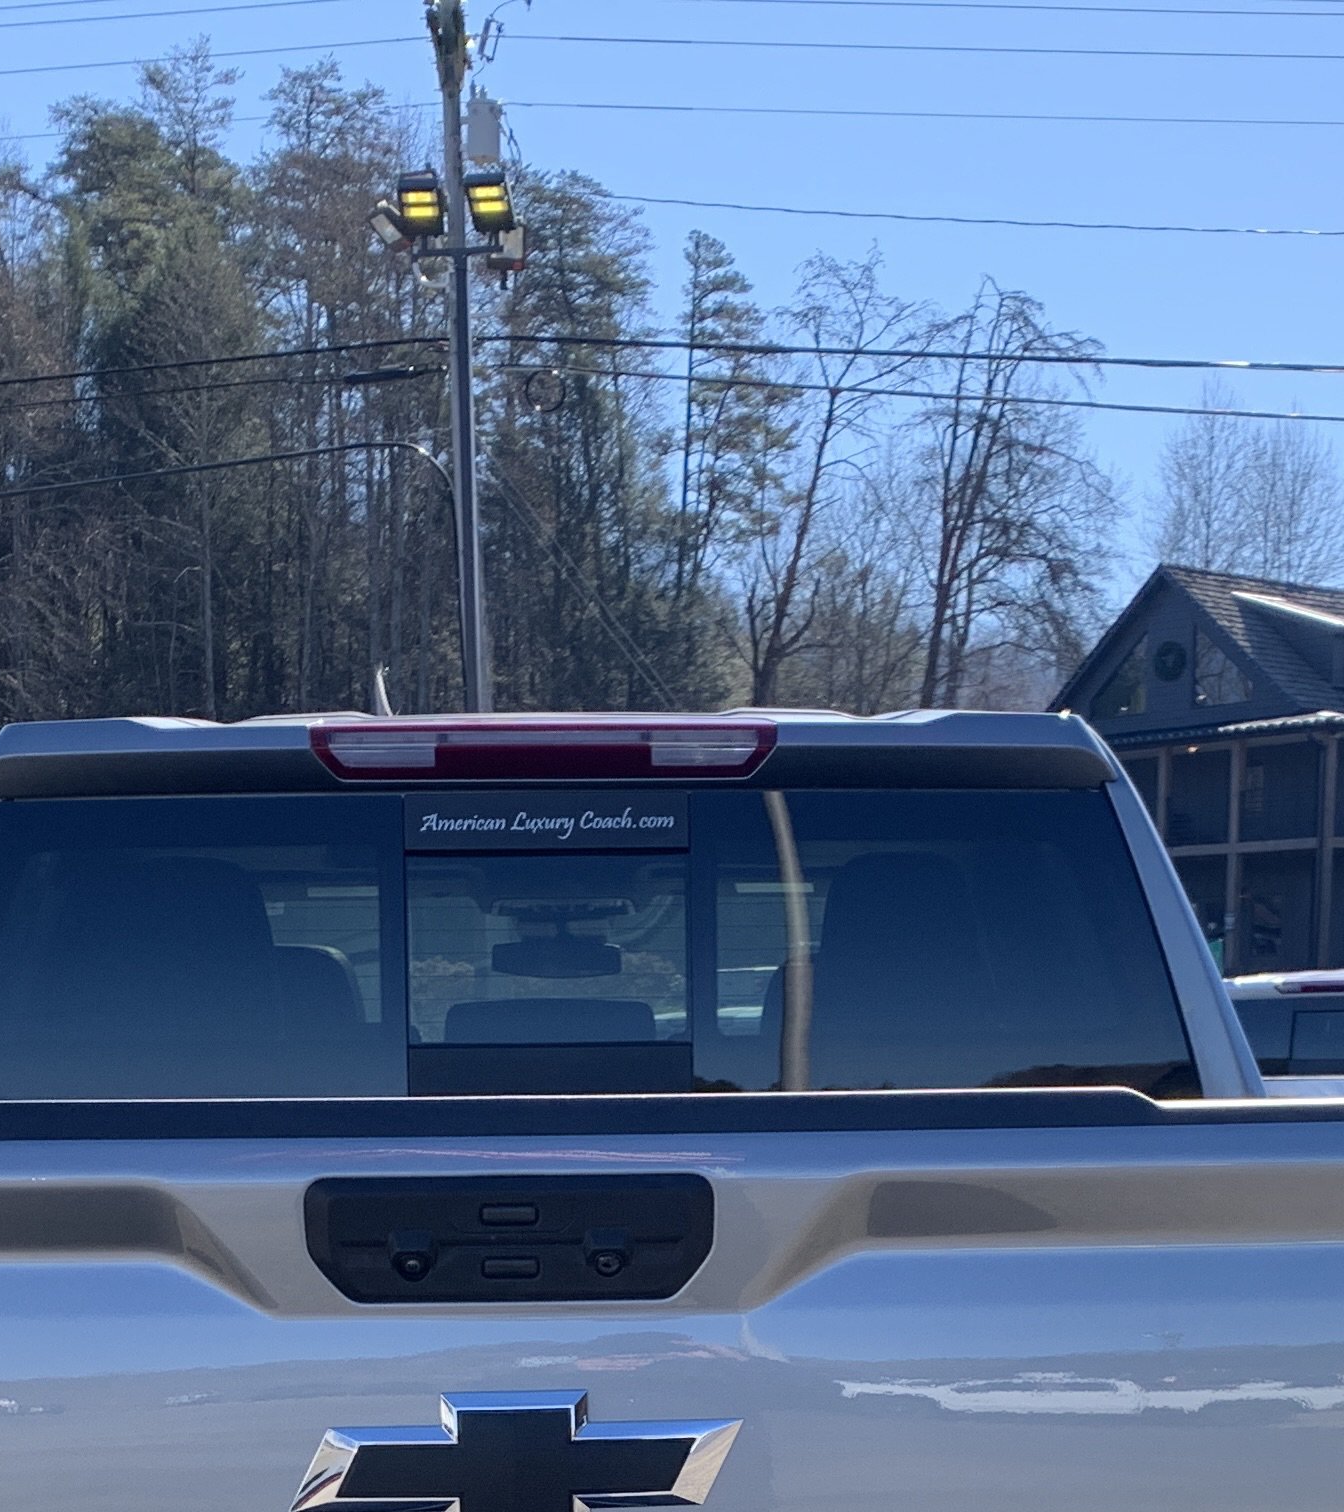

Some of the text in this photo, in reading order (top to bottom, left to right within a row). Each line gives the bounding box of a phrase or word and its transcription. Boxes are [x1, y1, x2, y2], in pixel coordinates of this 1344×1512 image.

[420, 808, 675, 840] American Luxury Coach.com
